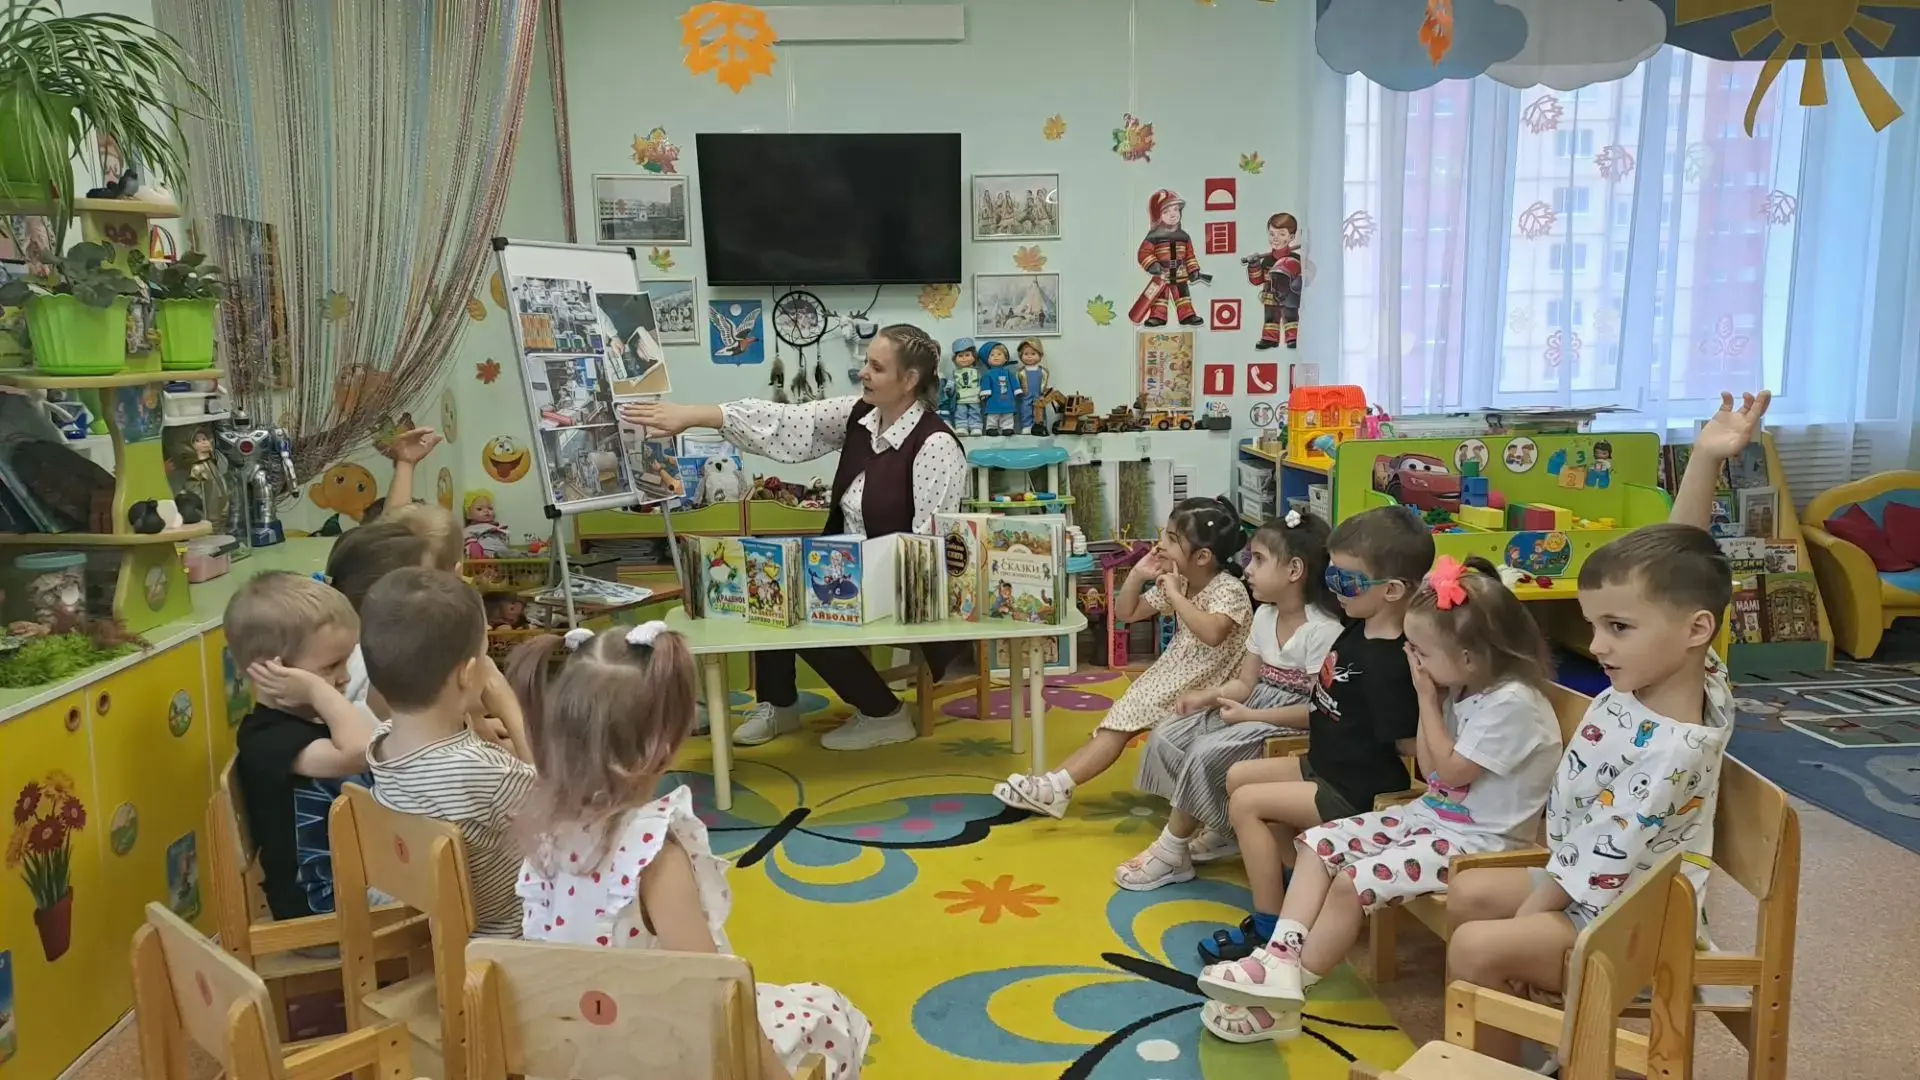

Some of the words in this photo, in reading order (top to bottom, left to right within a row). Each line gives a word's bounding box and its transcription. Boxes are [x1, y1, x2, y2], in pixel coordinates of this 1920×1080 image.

[1576, 450, 1586, 464] 3
[1566, 472, 1577, 487] 2
[1001, 560, 1040, 573] СКАЗКИ
[811, 610, 860, 623] АЙБОЛИТ
[595, 999, 601, 1016] 1
